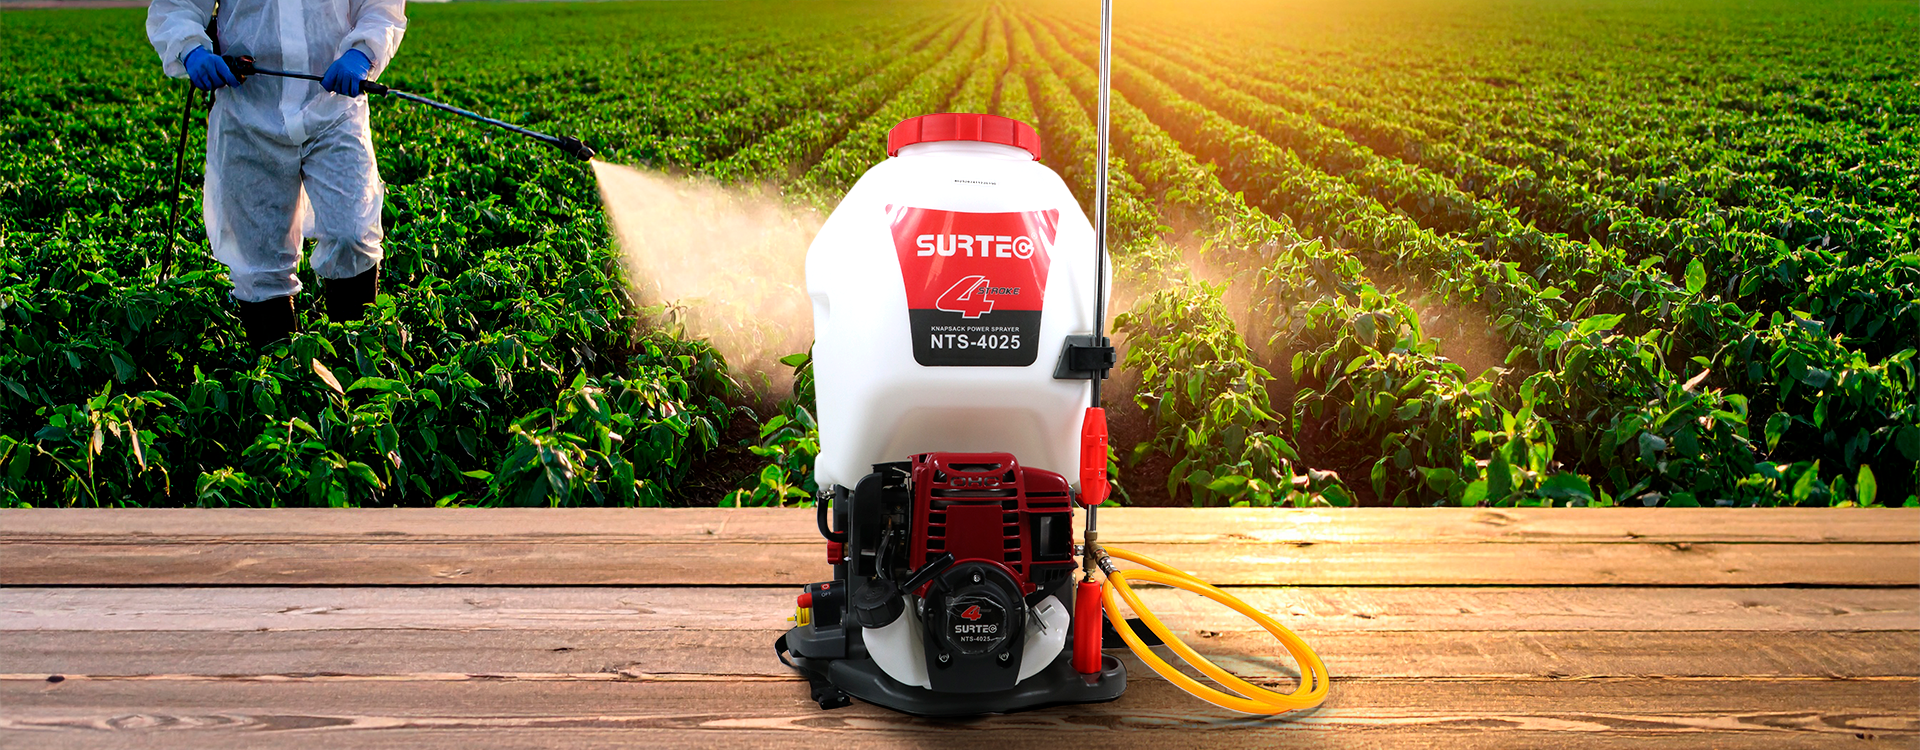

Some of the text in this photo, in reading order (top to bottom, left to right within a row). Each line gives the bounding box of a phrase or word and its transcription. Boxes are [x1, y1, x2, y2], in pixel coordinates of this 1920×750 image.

[916, 234, 1035, 260] SURTEC
[935, 275, 1021, 319] 4 STROKE
[930, 334, 1021, 349] NTS-4025
[950, 477, 999, 487] OHC
[960, 605, 982, 621] 4
[955, 624, 997, 634] SURTEC
